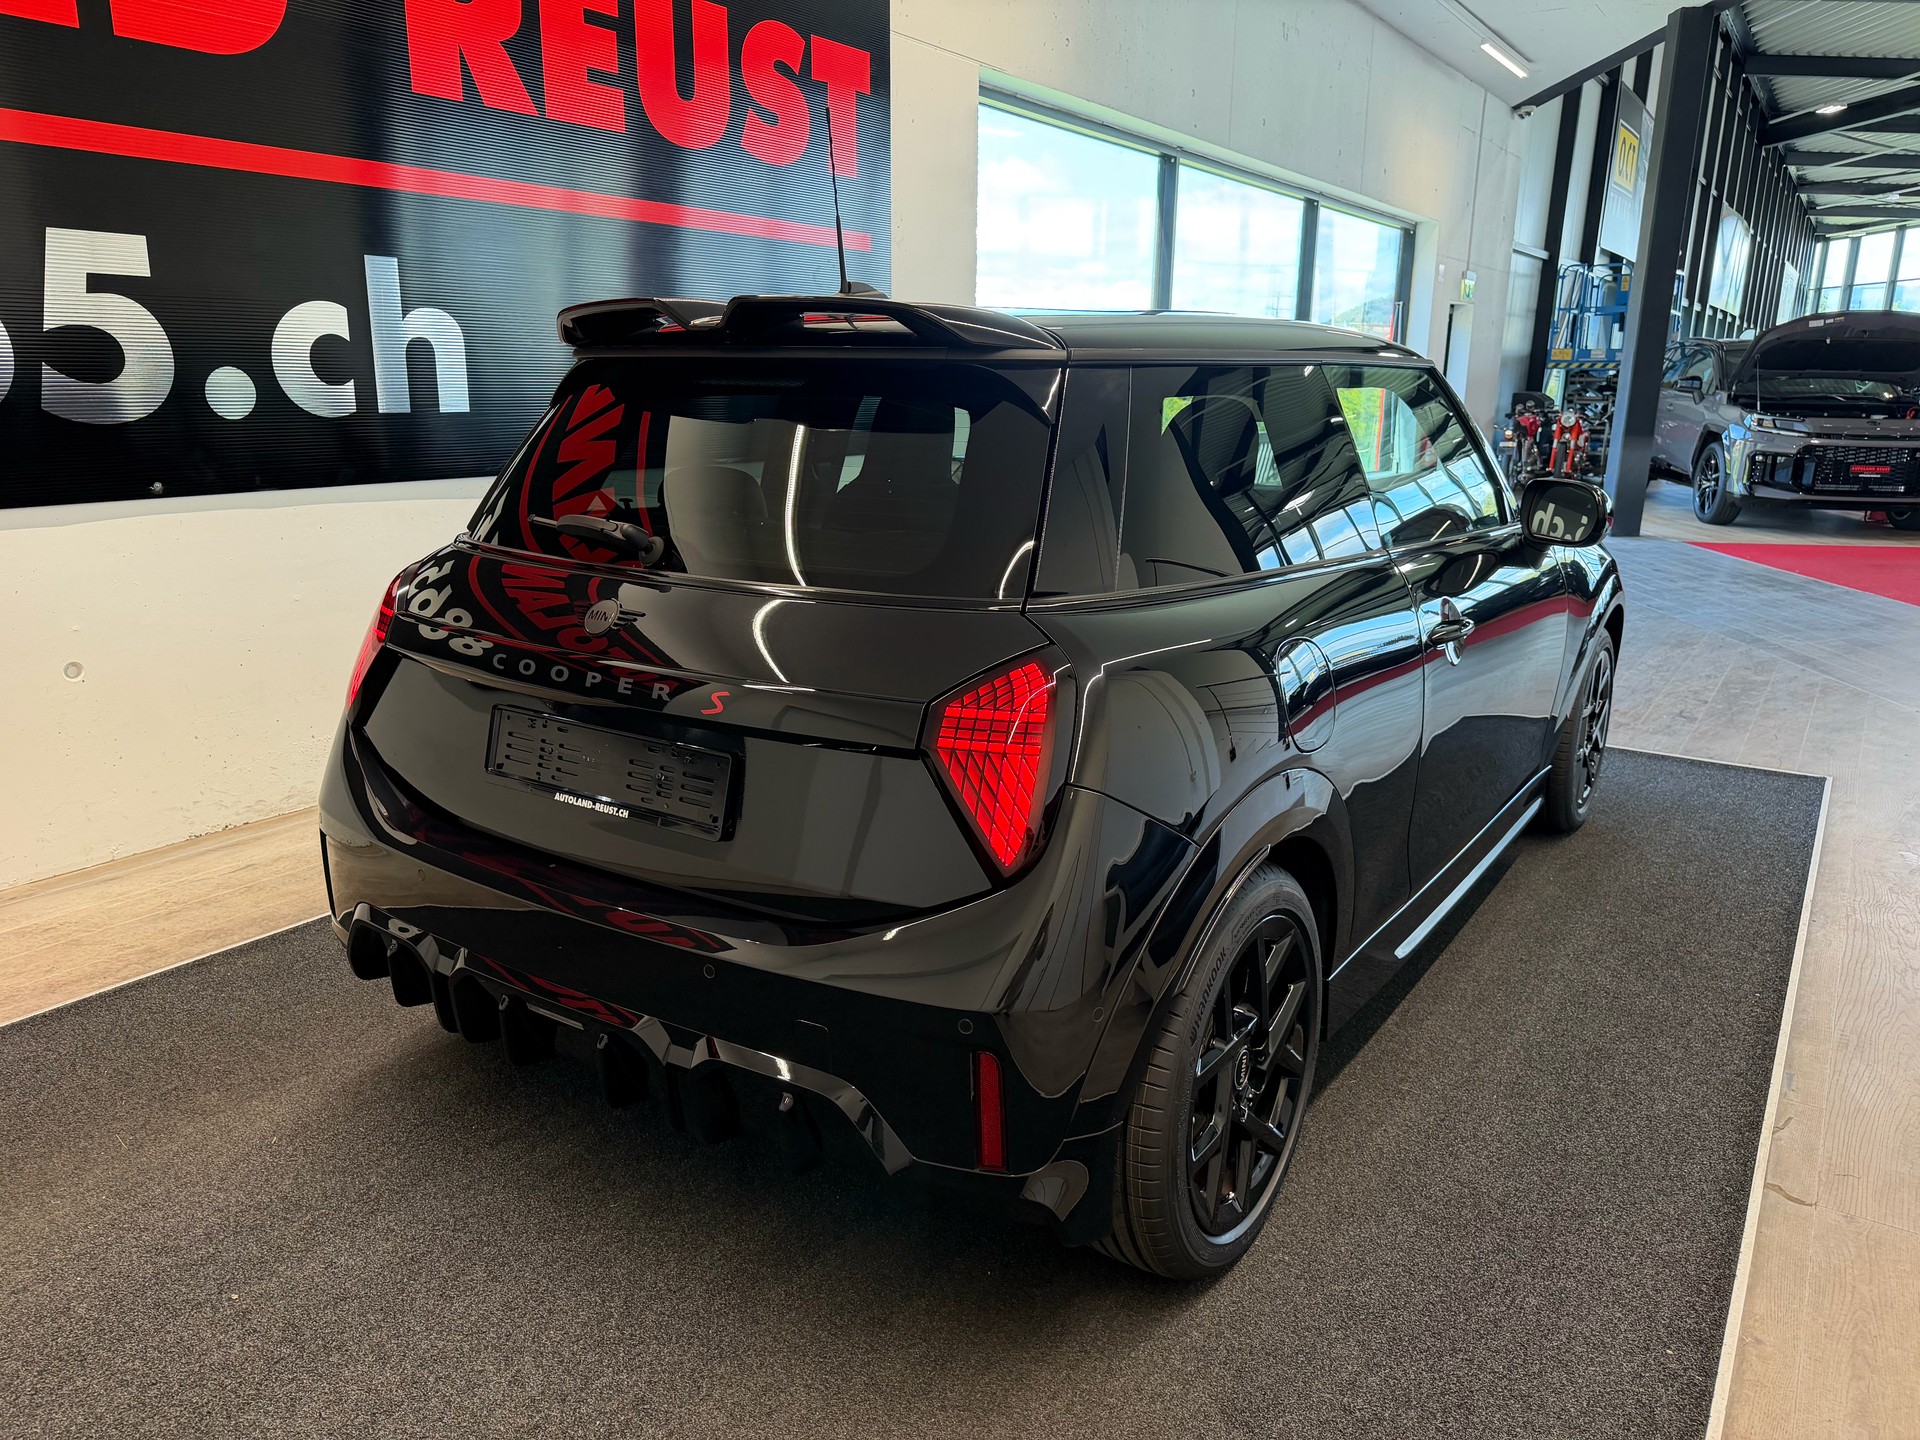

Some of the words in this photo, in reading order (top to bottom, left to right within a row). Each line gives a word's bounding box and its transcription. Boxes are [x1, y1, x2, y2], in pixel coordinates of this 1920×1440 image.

[405, 0, 871, 178] REUST
[0, 226, 470, 425] 5.ch
[492, 653, 671, 702] COOPER
[700, 691, 731, 715] S
[554, 792, 630, 819] AUTOLAND-REUST.CH
